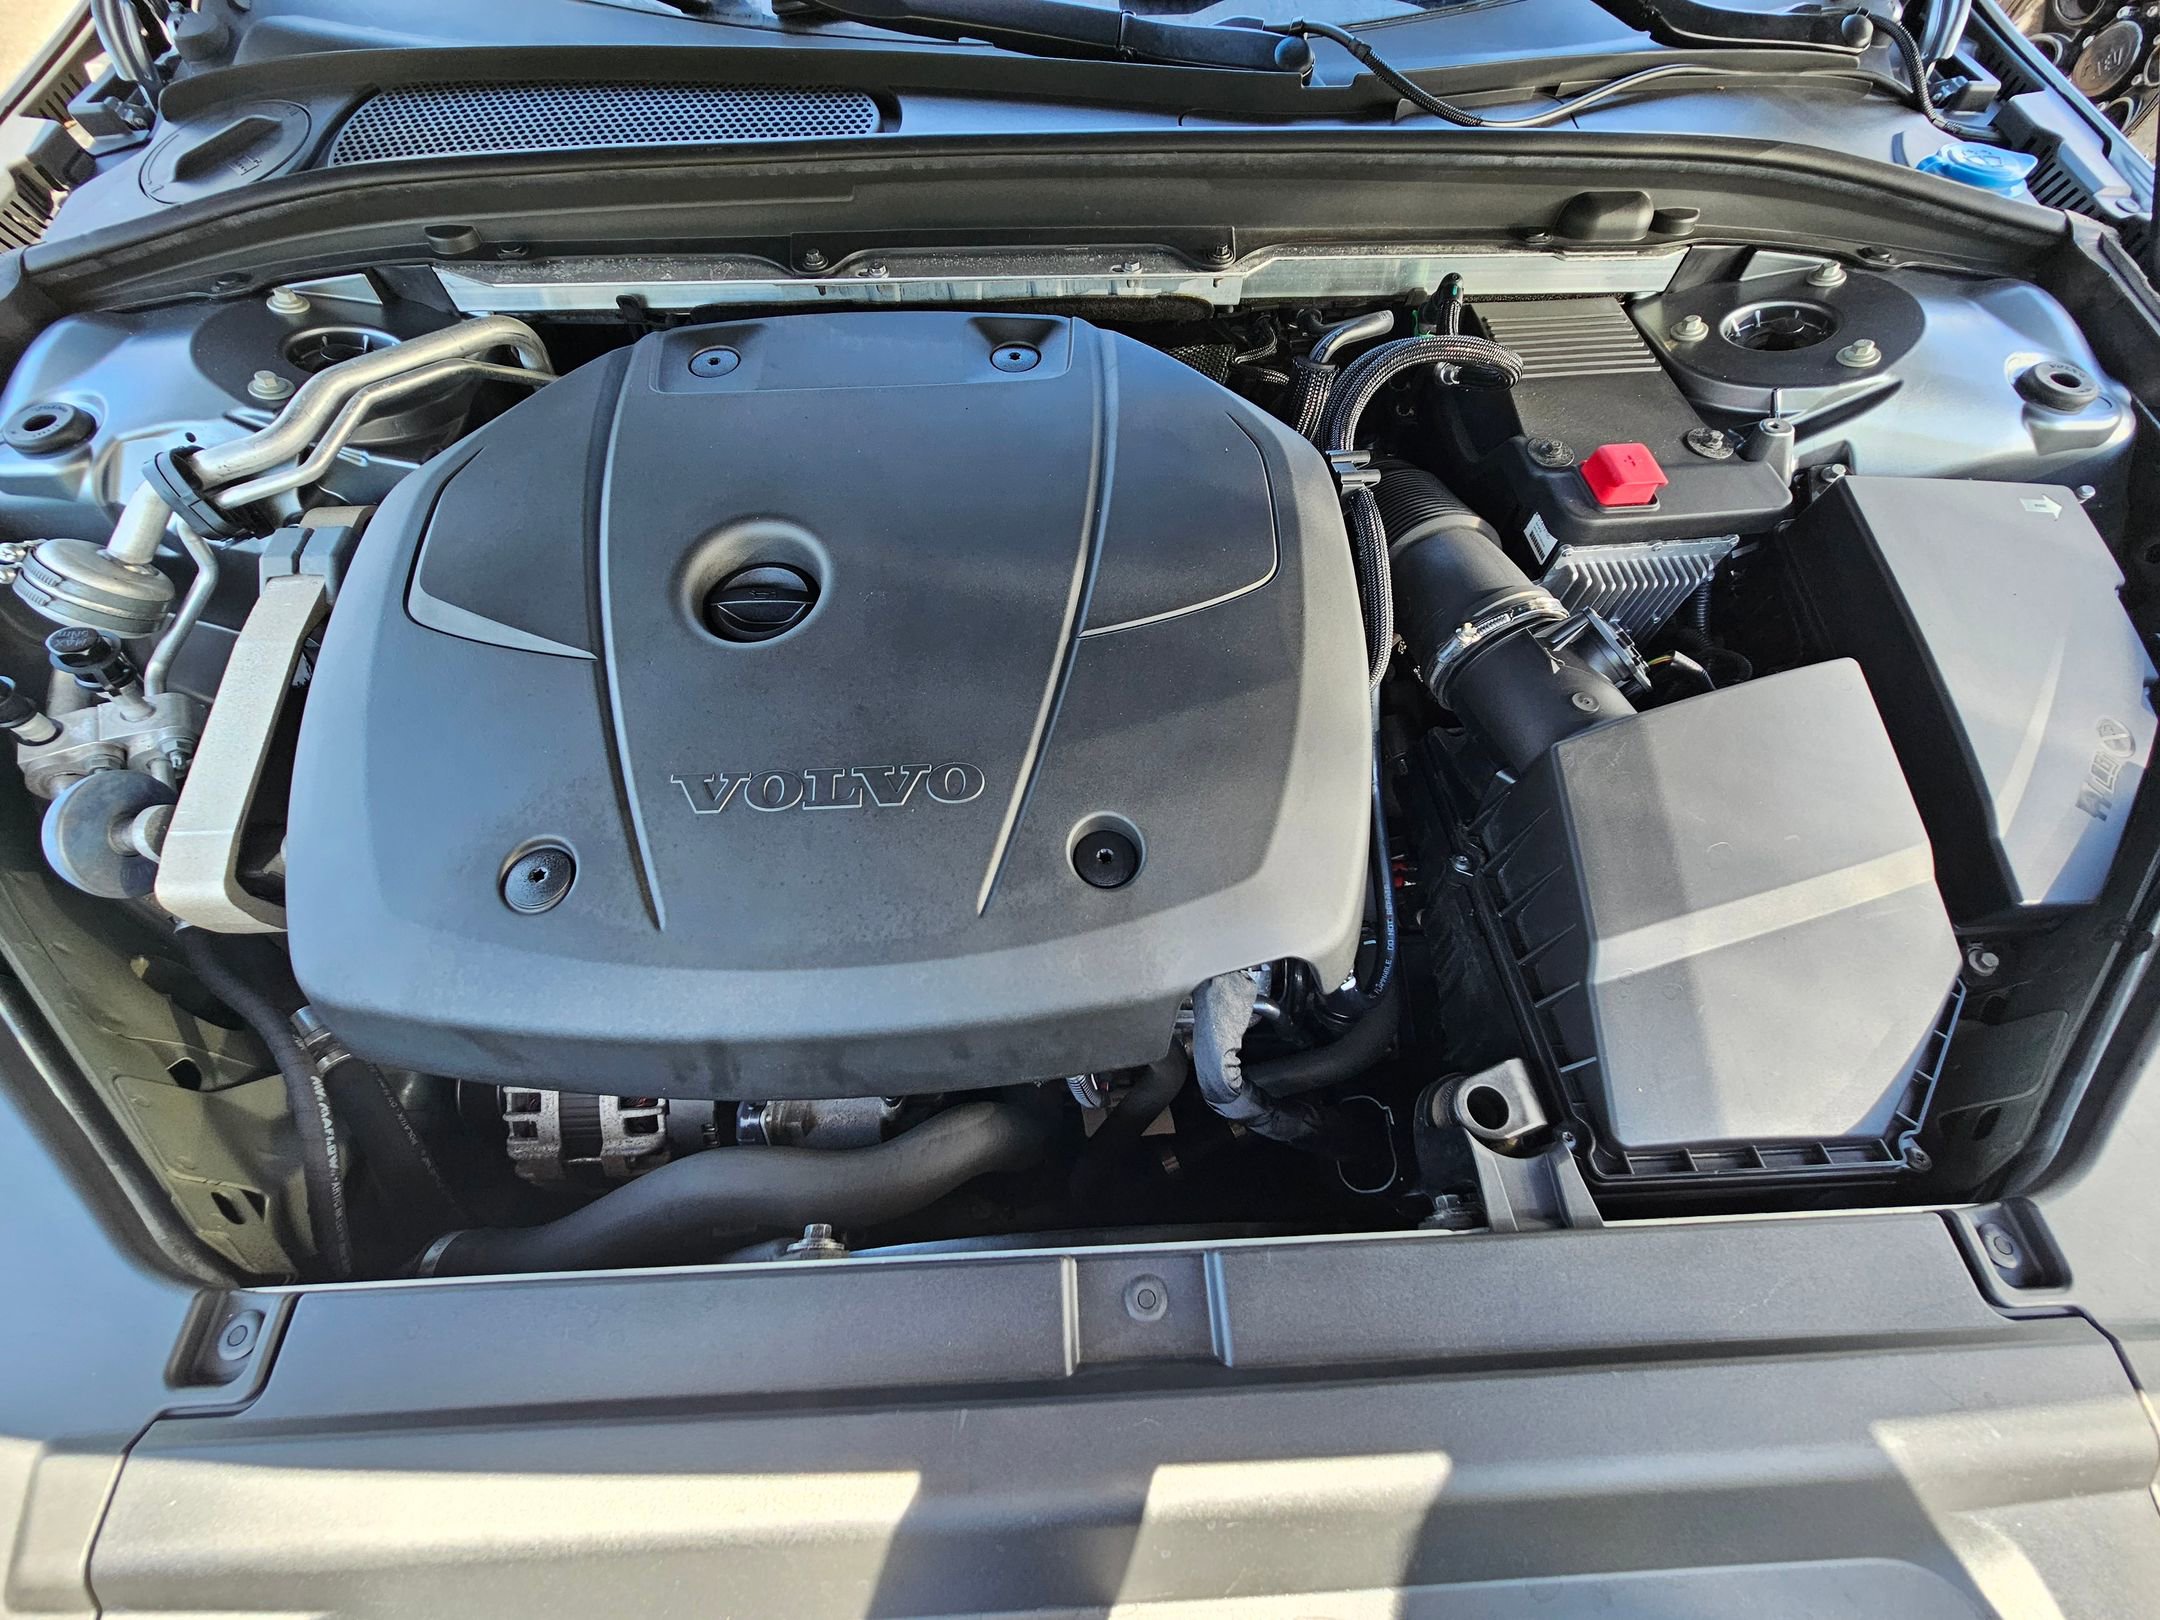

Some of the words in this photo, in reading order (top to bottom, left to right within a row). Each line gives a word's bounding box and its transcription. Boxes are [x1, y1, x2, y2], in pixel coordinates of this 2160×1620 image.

[54, 639, 88, 647] MAX
[670, 762, 986, 814] VOLVO
[1386, 920, 1395, 936] NOT
[1387, 939, 1395, 951] DO
